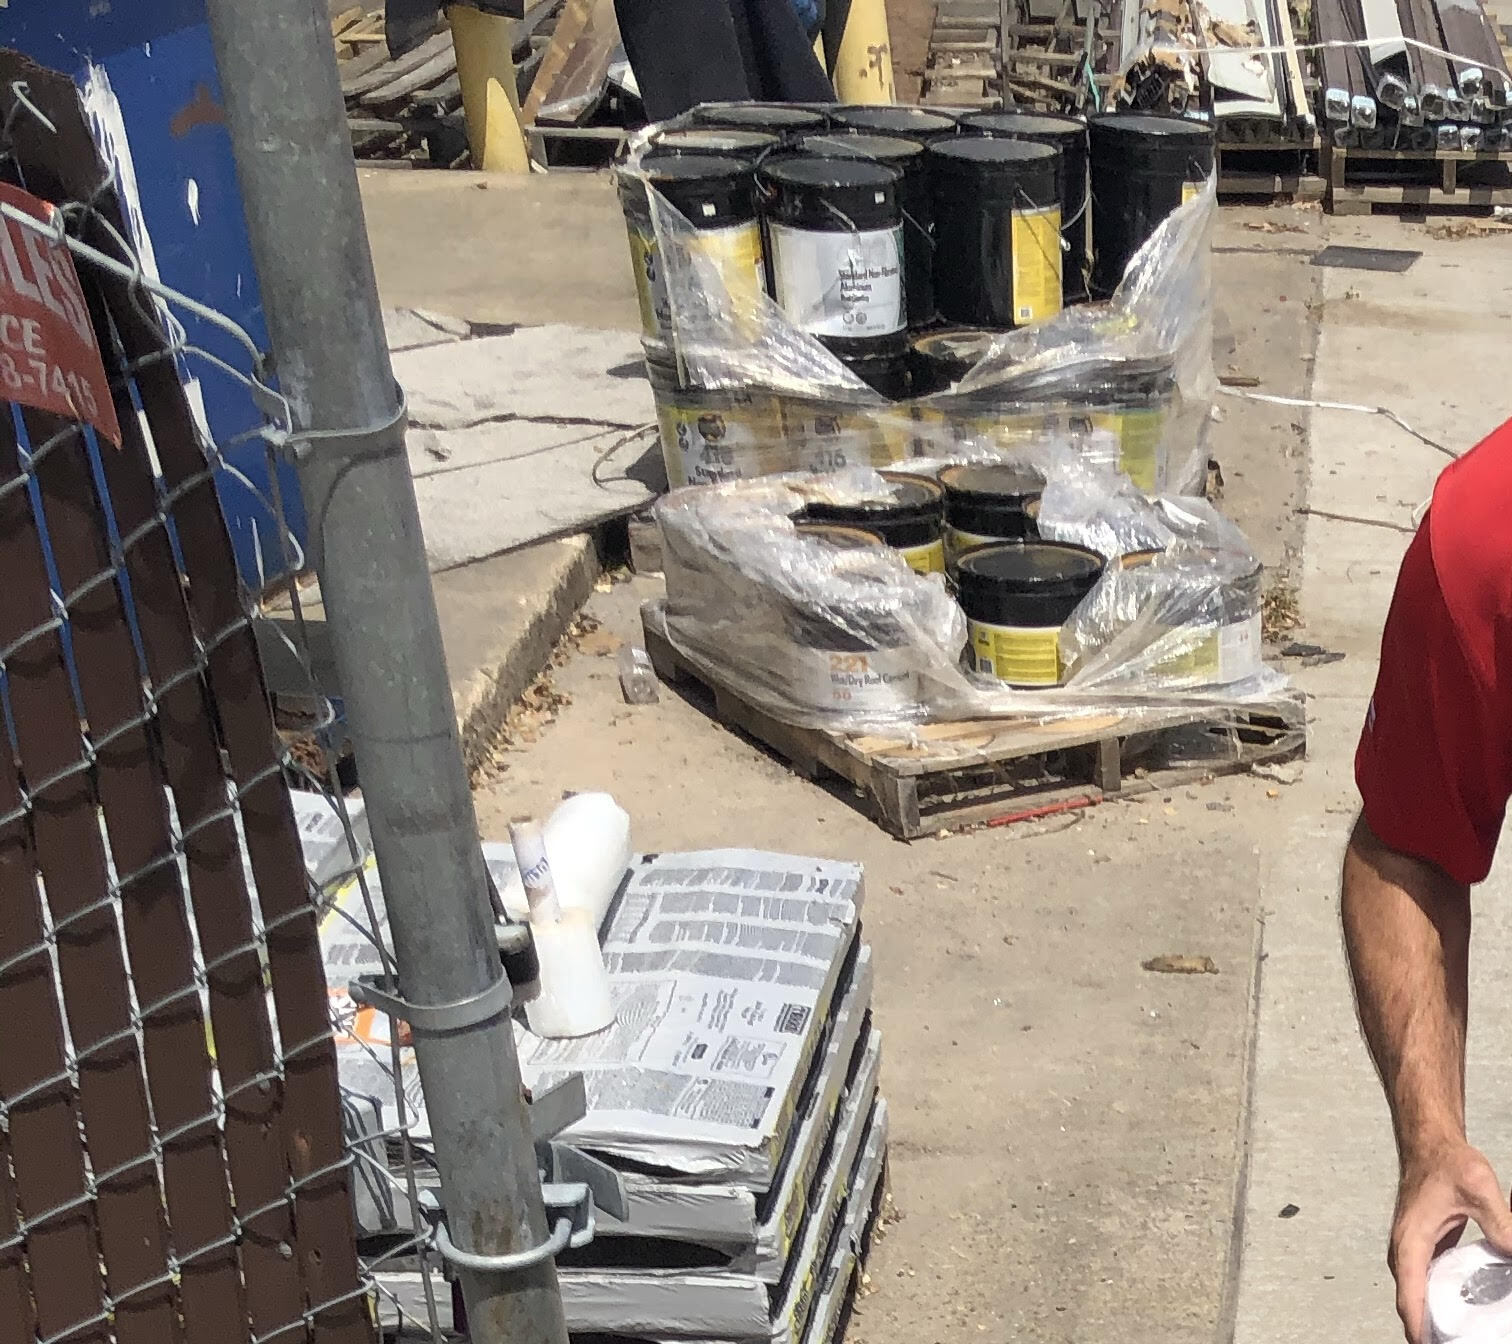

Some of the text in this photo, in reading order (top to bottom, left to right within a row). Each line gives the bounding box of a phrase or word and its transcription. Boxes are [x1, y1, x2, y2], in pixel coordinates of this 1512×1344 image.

[0, 215, 95, 350] LES
[0, 313, 46, 354] CE
[0, 352, 98, 416] 8-7415
